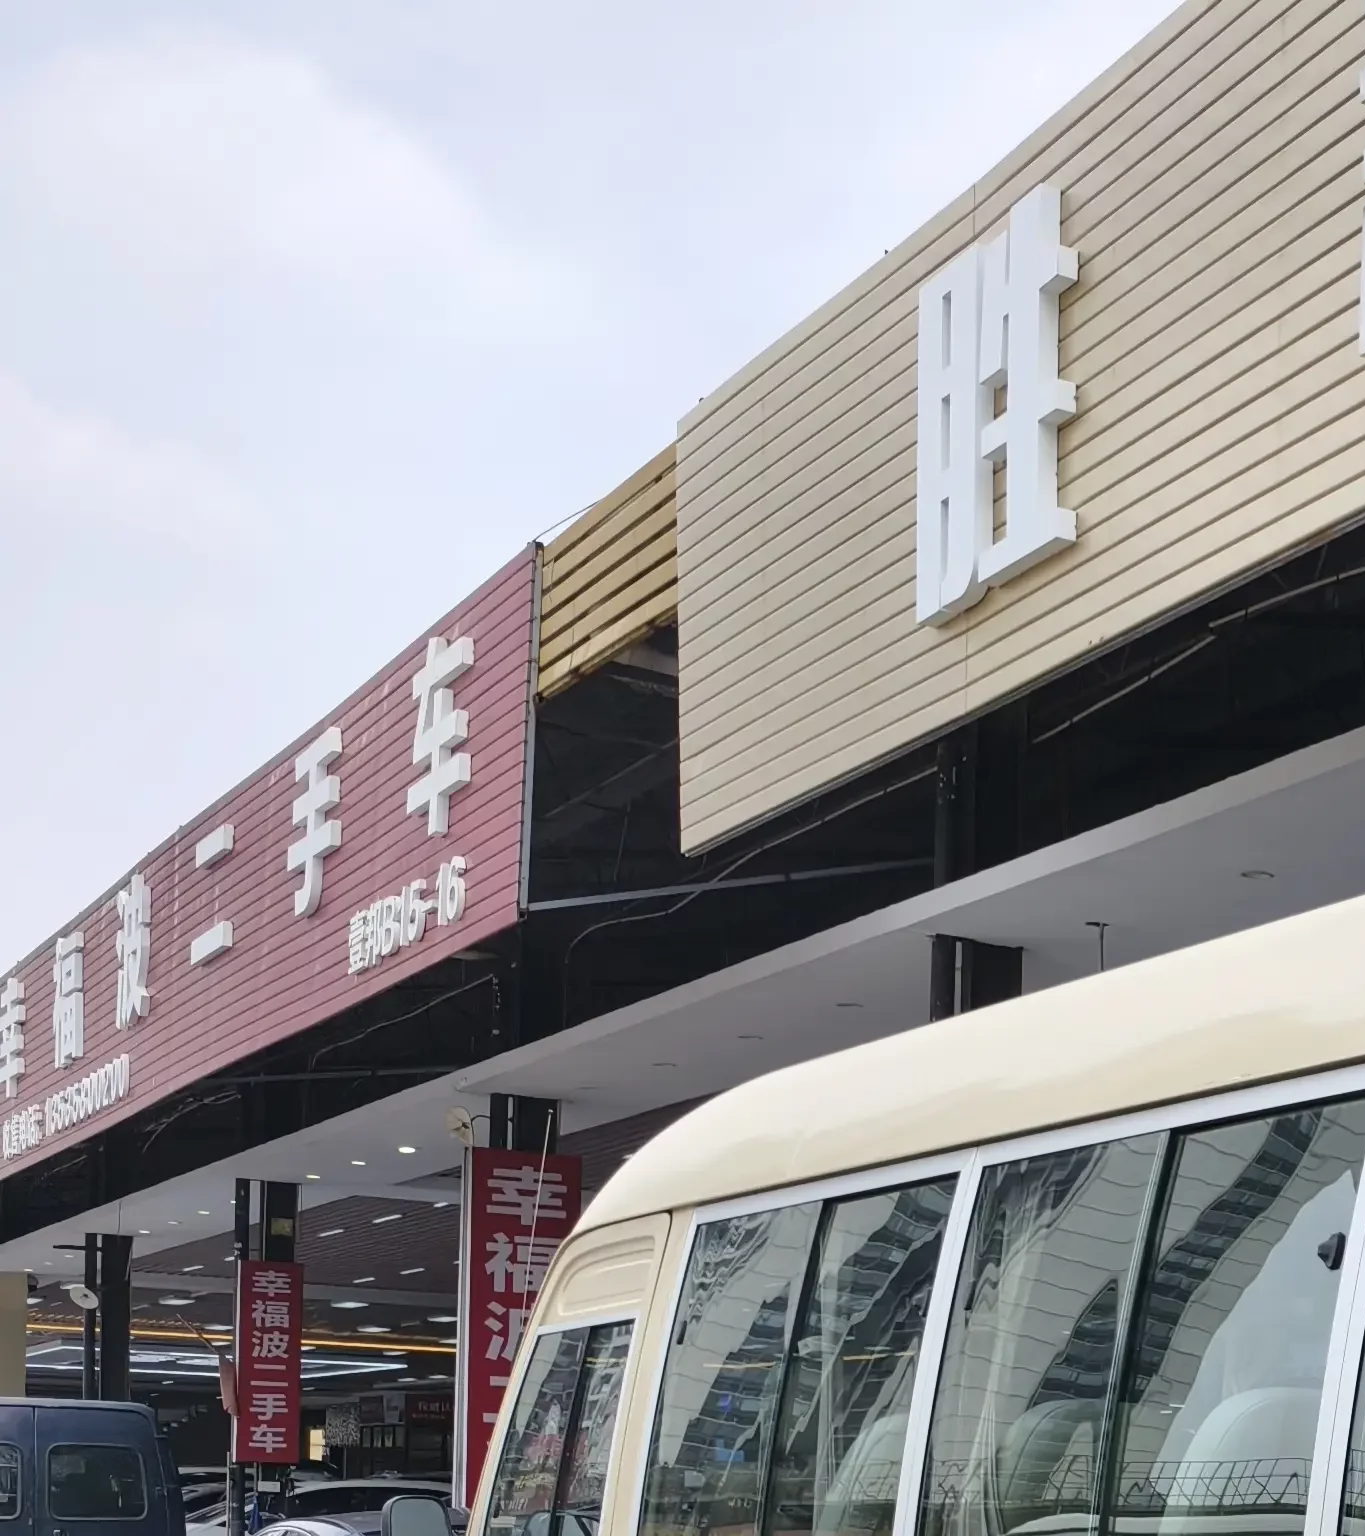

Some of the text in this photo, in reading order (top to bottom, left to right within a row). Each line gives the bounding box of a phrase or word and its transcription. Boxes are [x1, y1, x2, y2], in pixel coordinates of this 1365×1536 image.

[248, 1270, 292, 1453] 幸福波二手车
